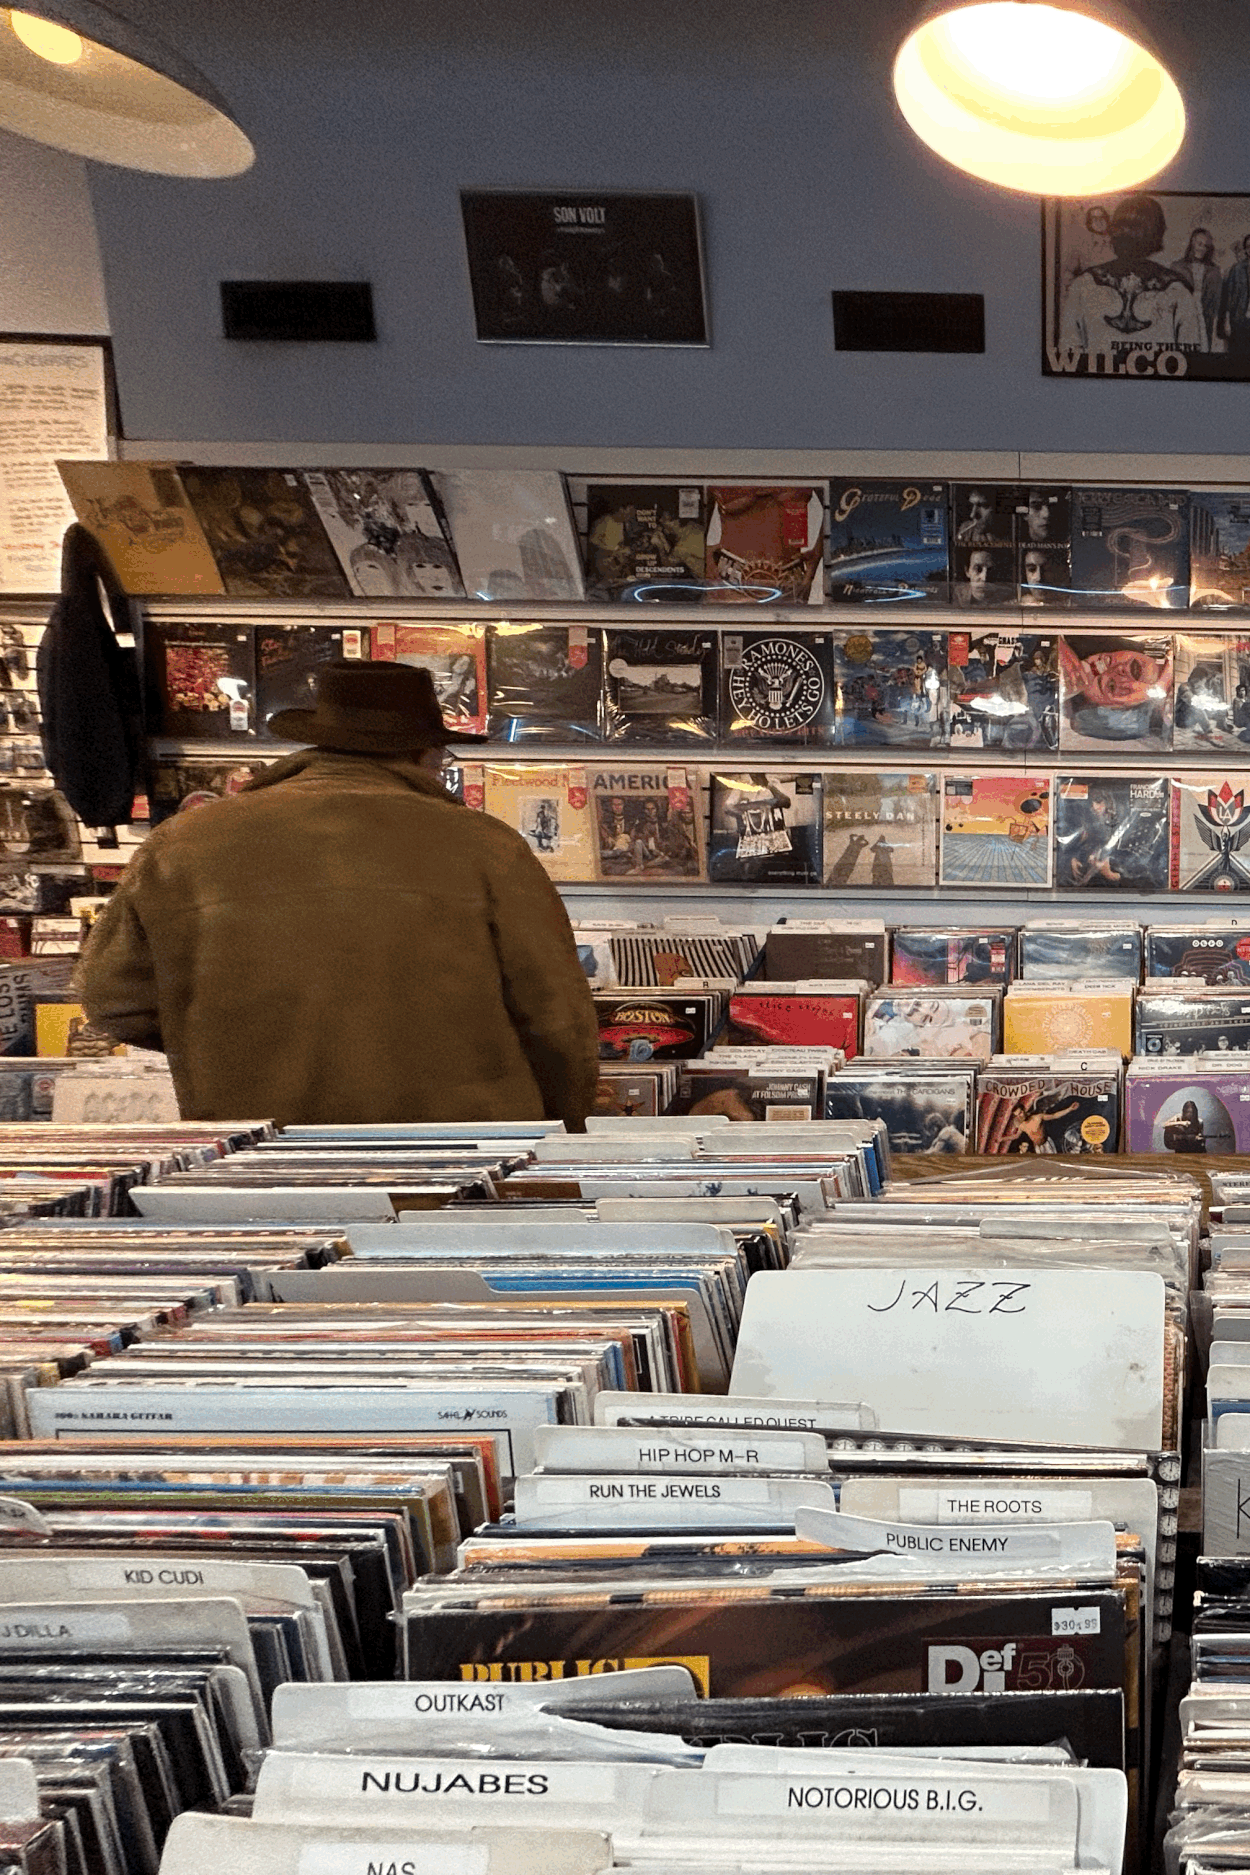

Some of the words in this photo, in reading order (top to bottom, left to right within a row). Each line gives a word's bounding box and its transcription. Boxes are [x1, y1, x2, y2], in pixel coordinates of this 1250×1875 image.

[553, 207, 577, 223] SON
[579, 207, 606, 223] VOLT
[1111, 341, 1154, 352] BEING
[1156, 342, 1201, 352] THERE
[1046, 347, 1188, 376] WILCO
[741, 641, 814, 671] RAMONES
[732, 675, 751, 710] HEY
[747, 711, 771, 730] HO
[807, 676, 821, 702] GO
[825, 811, 881, 820] STEELY
[886, 811, 916, 821] DAN
[1218, 806, 1232, 820] LA
[615, 1010, 670, 1023] BOSTON
[1080, 1062, 1088, 1071] C
[752, 1090, 761, 1099] AT
[761, 1090, 786, 1099] FOLSOM
[766, 1083, 794, 1091] JOHNNY
[794, 1083, 811, 1091] CASH
[985, 1079, 1046, 1098] CROWDED
[1070, 1081, 1112, 1096] HOUSE
[867, 1279, 1031, 1314] JAZZ
[476, 1410, 508, 1420] SOUNDS
[639, 1448, 671, 1463] HIP
[674, 1449, 716, 1463] HOP
[589, 1484, 624, 1498] RUN
[628, 1484, 657, 1498] THE
[660, 1484, 721, 1499] JEWELS
[947, 1500, 980, 1513] THE
[984, 1501, 1043, 1514] ROOTS
[886, 1532, 944, 1552] PUBLIC
[949, 1537, 1009, 1552] ENEMY
[124, 1570, 154, 1584] KID
[158, 1569, 205, 1585] CUDI
[1, 1625, 12, 1638] J
[14, 1624, 72, 1638] DILLA
[928, 1642, 1017, 1692] Def
[415, 1693, 505, 1713] OUTKAST
[361, 1771, 549, 1795] NUJABES
[787, 1787, 920, 1810] NOTORIOUS
[926, 1789, 984, 1812] B.I.G.
[366, 1861, 417, 1875] NAS
